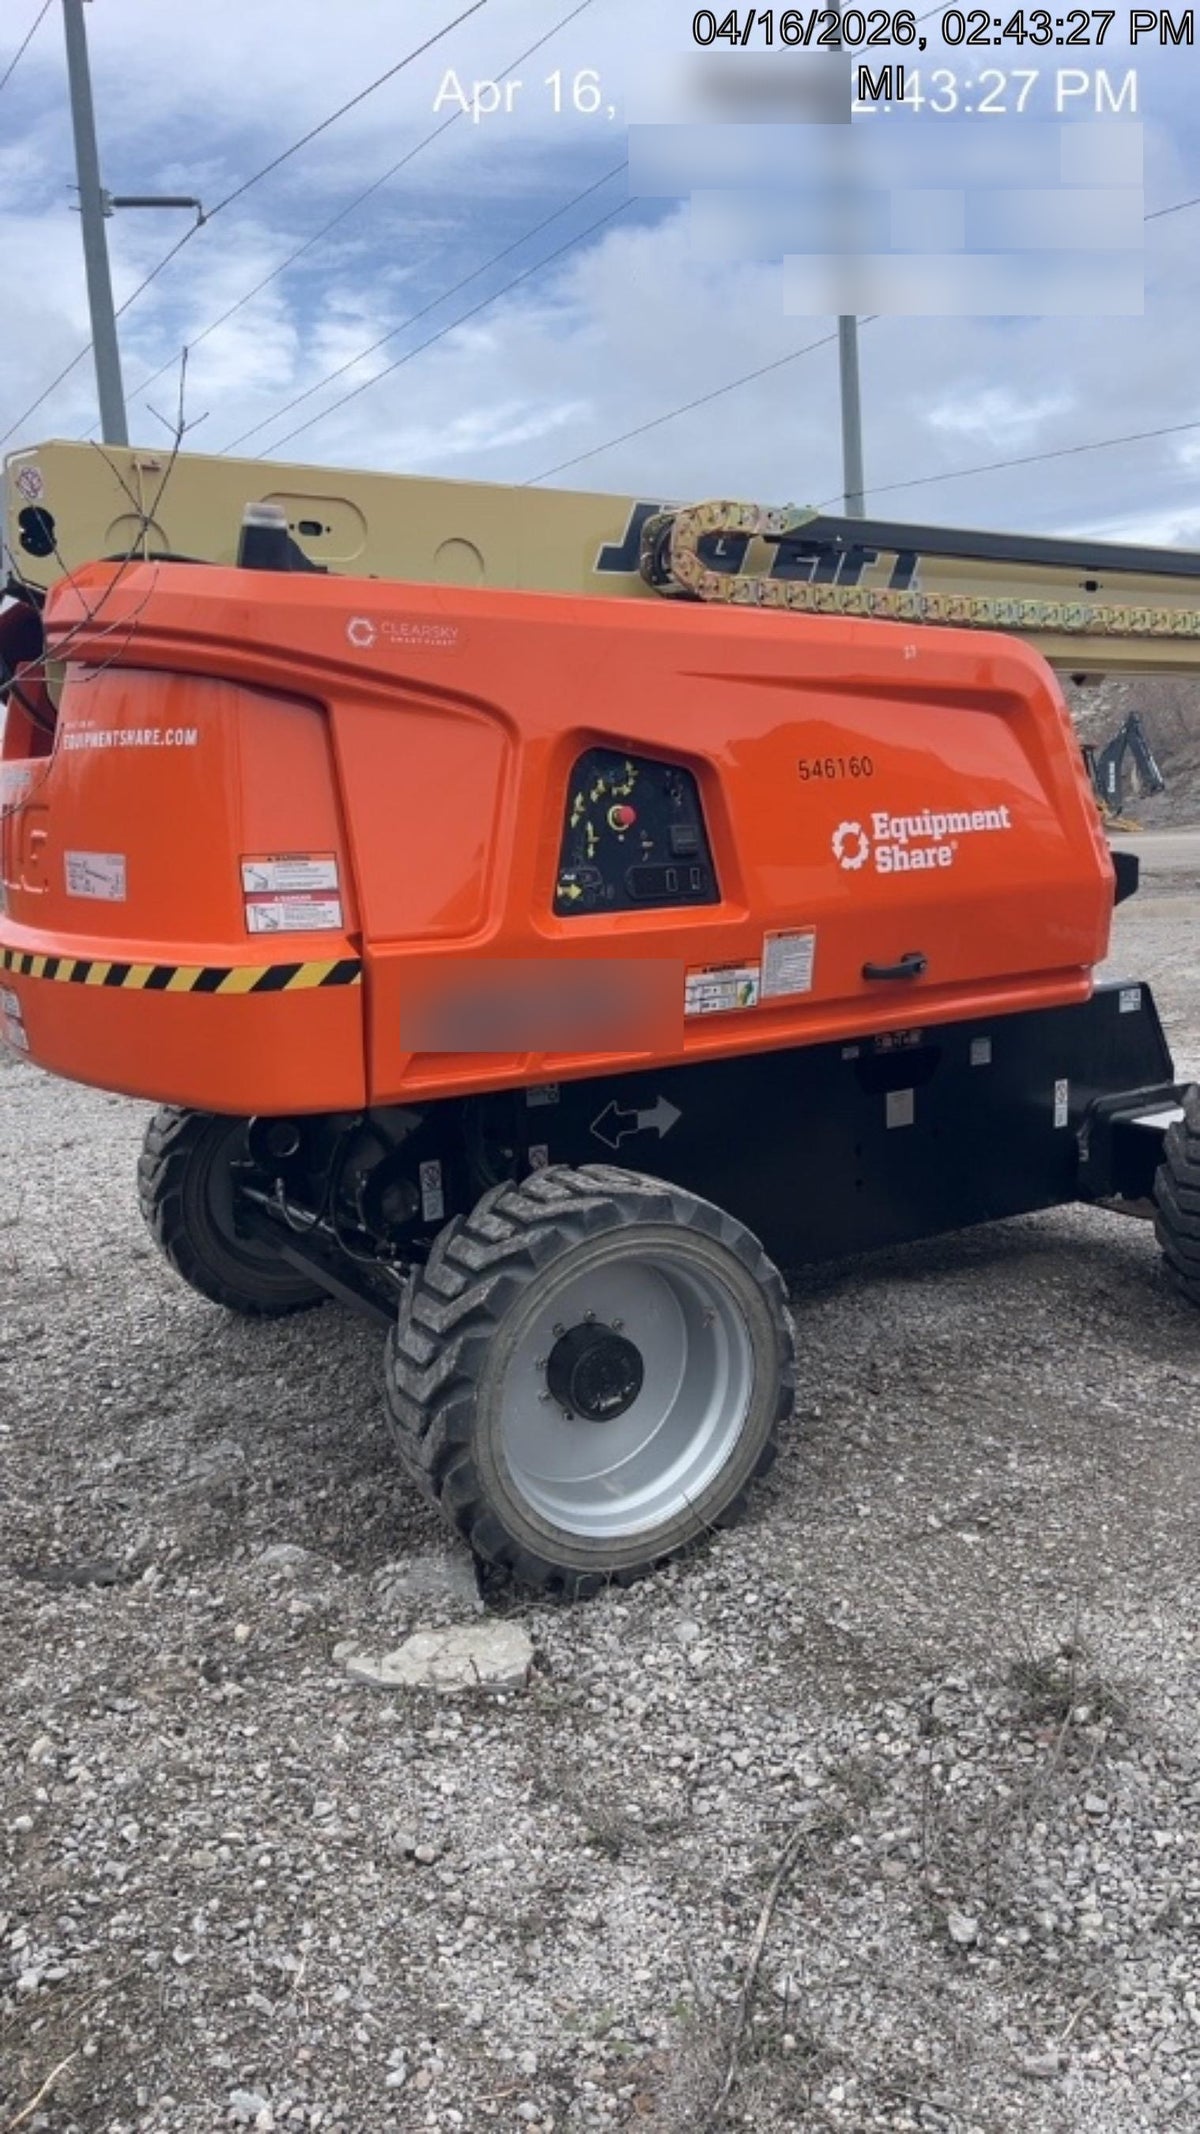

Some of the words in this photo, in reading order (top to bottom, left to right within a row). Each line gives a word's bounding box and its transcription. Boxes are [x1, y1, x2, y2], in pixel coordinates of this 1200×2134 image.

[380, 620, 460, 640] CLEARSKY
[62, 727, 199, 750] EQUIPMENTSHARE.COM
[798, 755, 874, 781] 546160
[870, 804, 1012, 844] Equipment
